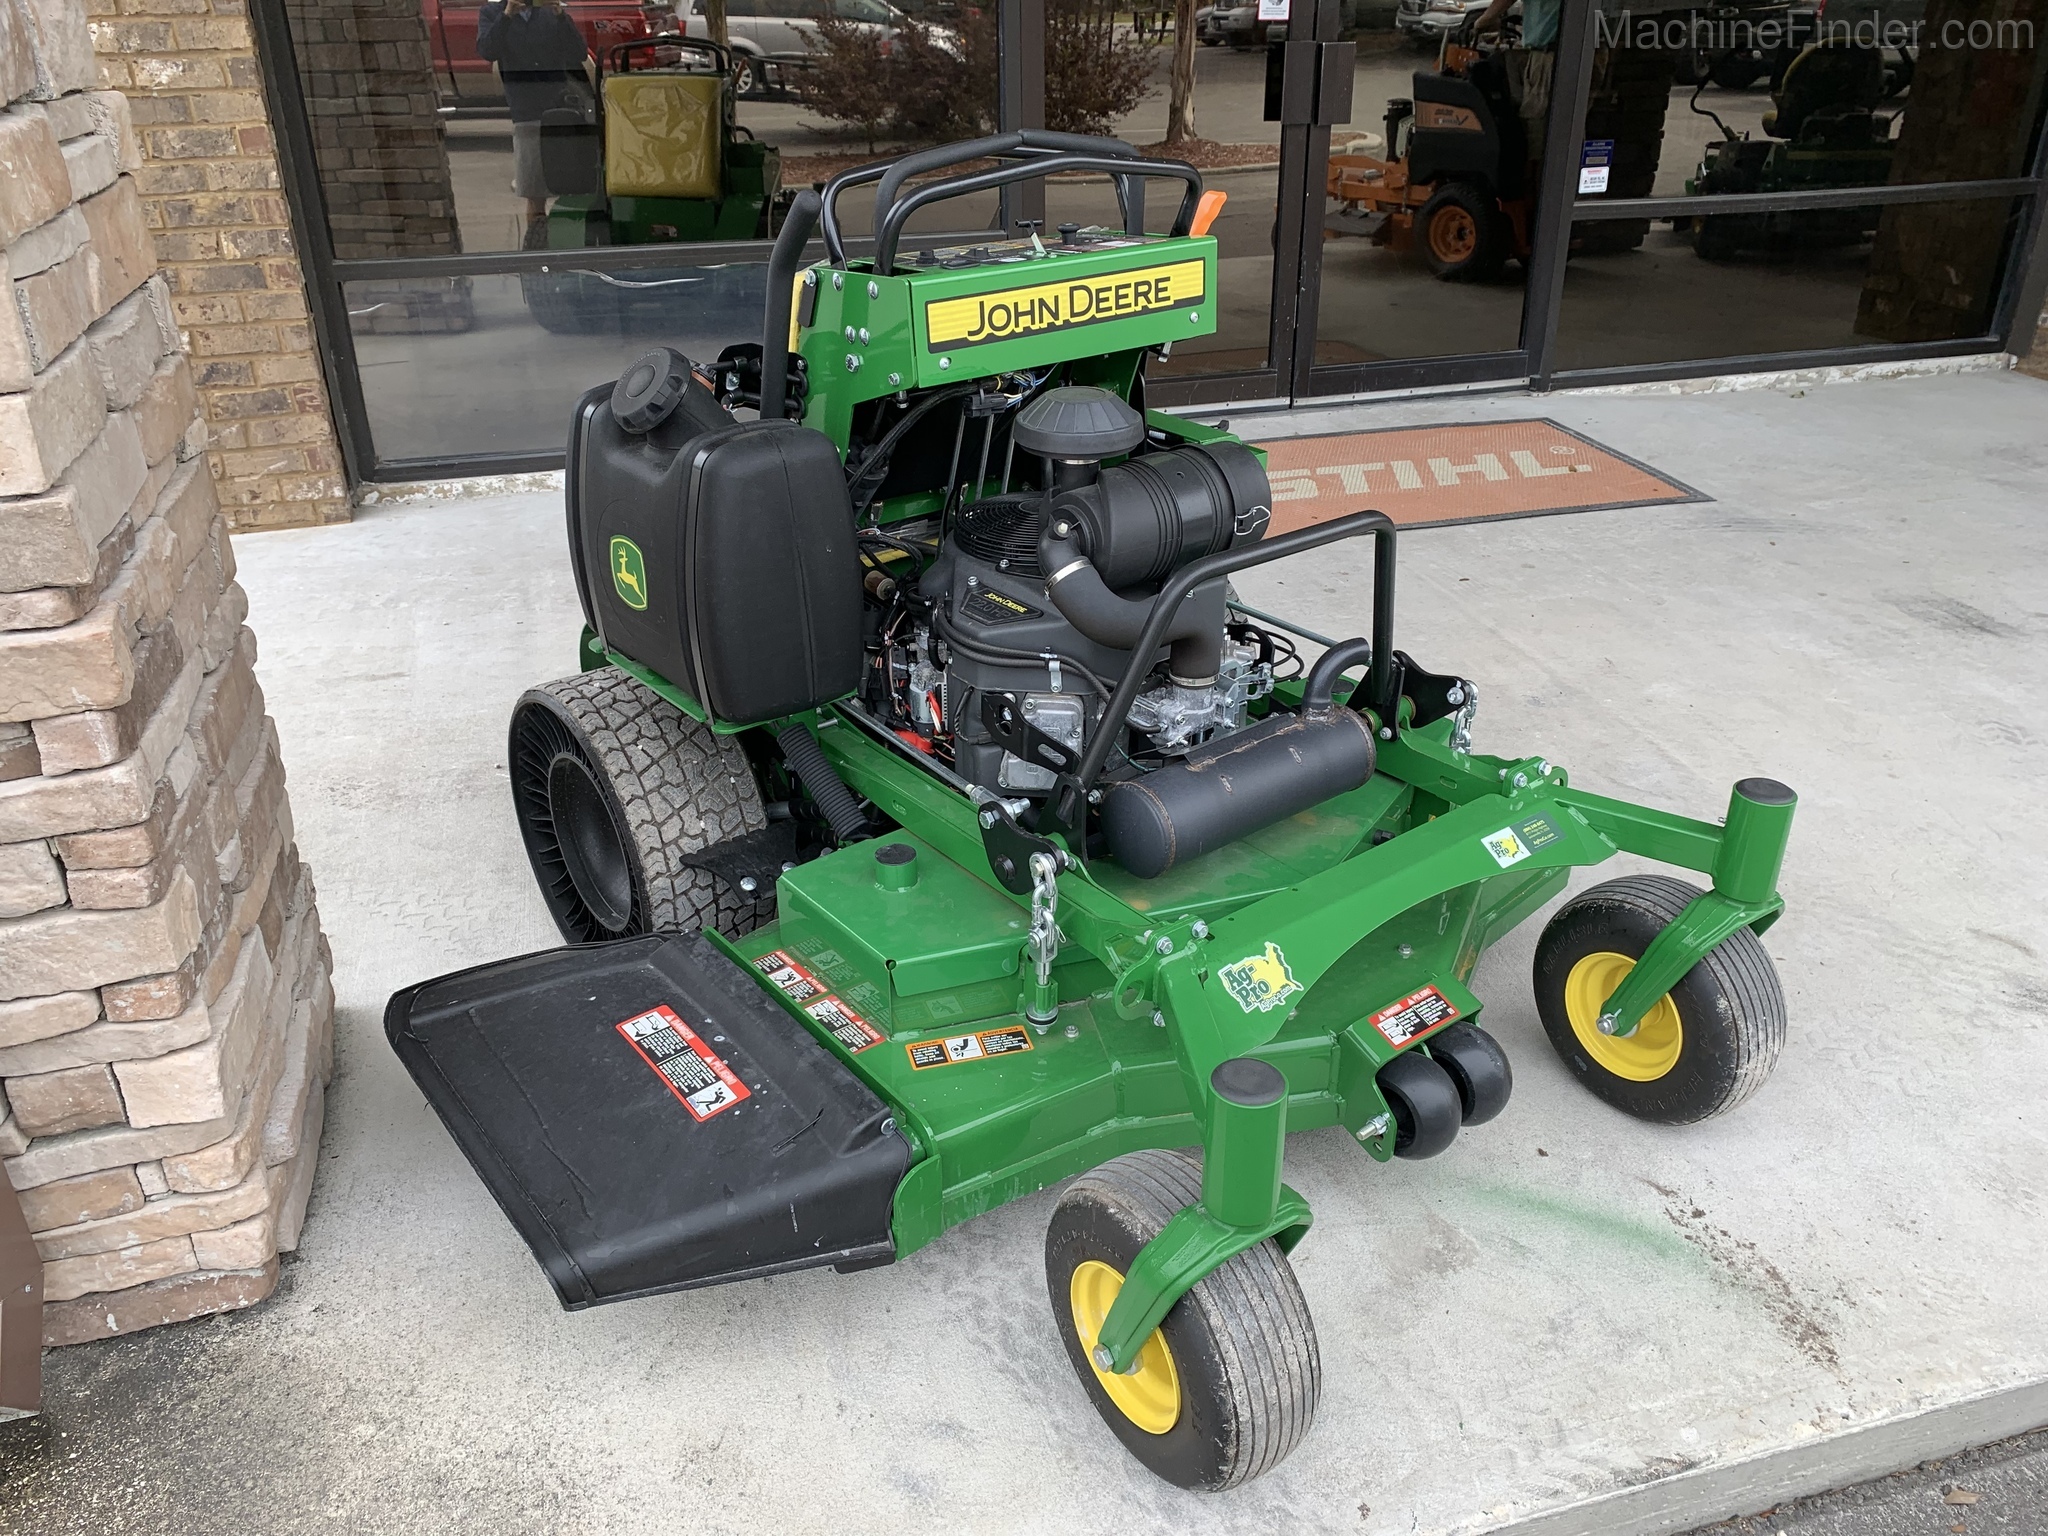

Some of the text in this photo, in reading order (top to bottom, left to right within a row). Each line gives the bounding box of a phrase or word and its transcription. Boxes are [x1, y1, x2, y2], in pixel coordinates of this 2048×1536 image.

[967, 276, 1172, 337] JOHN DEERE
[1266, 450, 1592, 502] STIHL
[984, 592, 1028, 614] JOHN DEERE
[1223, 965, 1256, 991] Ag-
[1235, 980, 1270, 1008] Pro
[1382, 1003, 1404, 1018] DANGER
[1411, 987, 1434, 1002] PELIGRO
[839, 1003, 856, 1018] DANGER
[860, 1023, 882, 1040] PELIGRO
[669, 1019, 696, 1040] DANGER
[710, 1060, 738, 1086] PELIGRO
